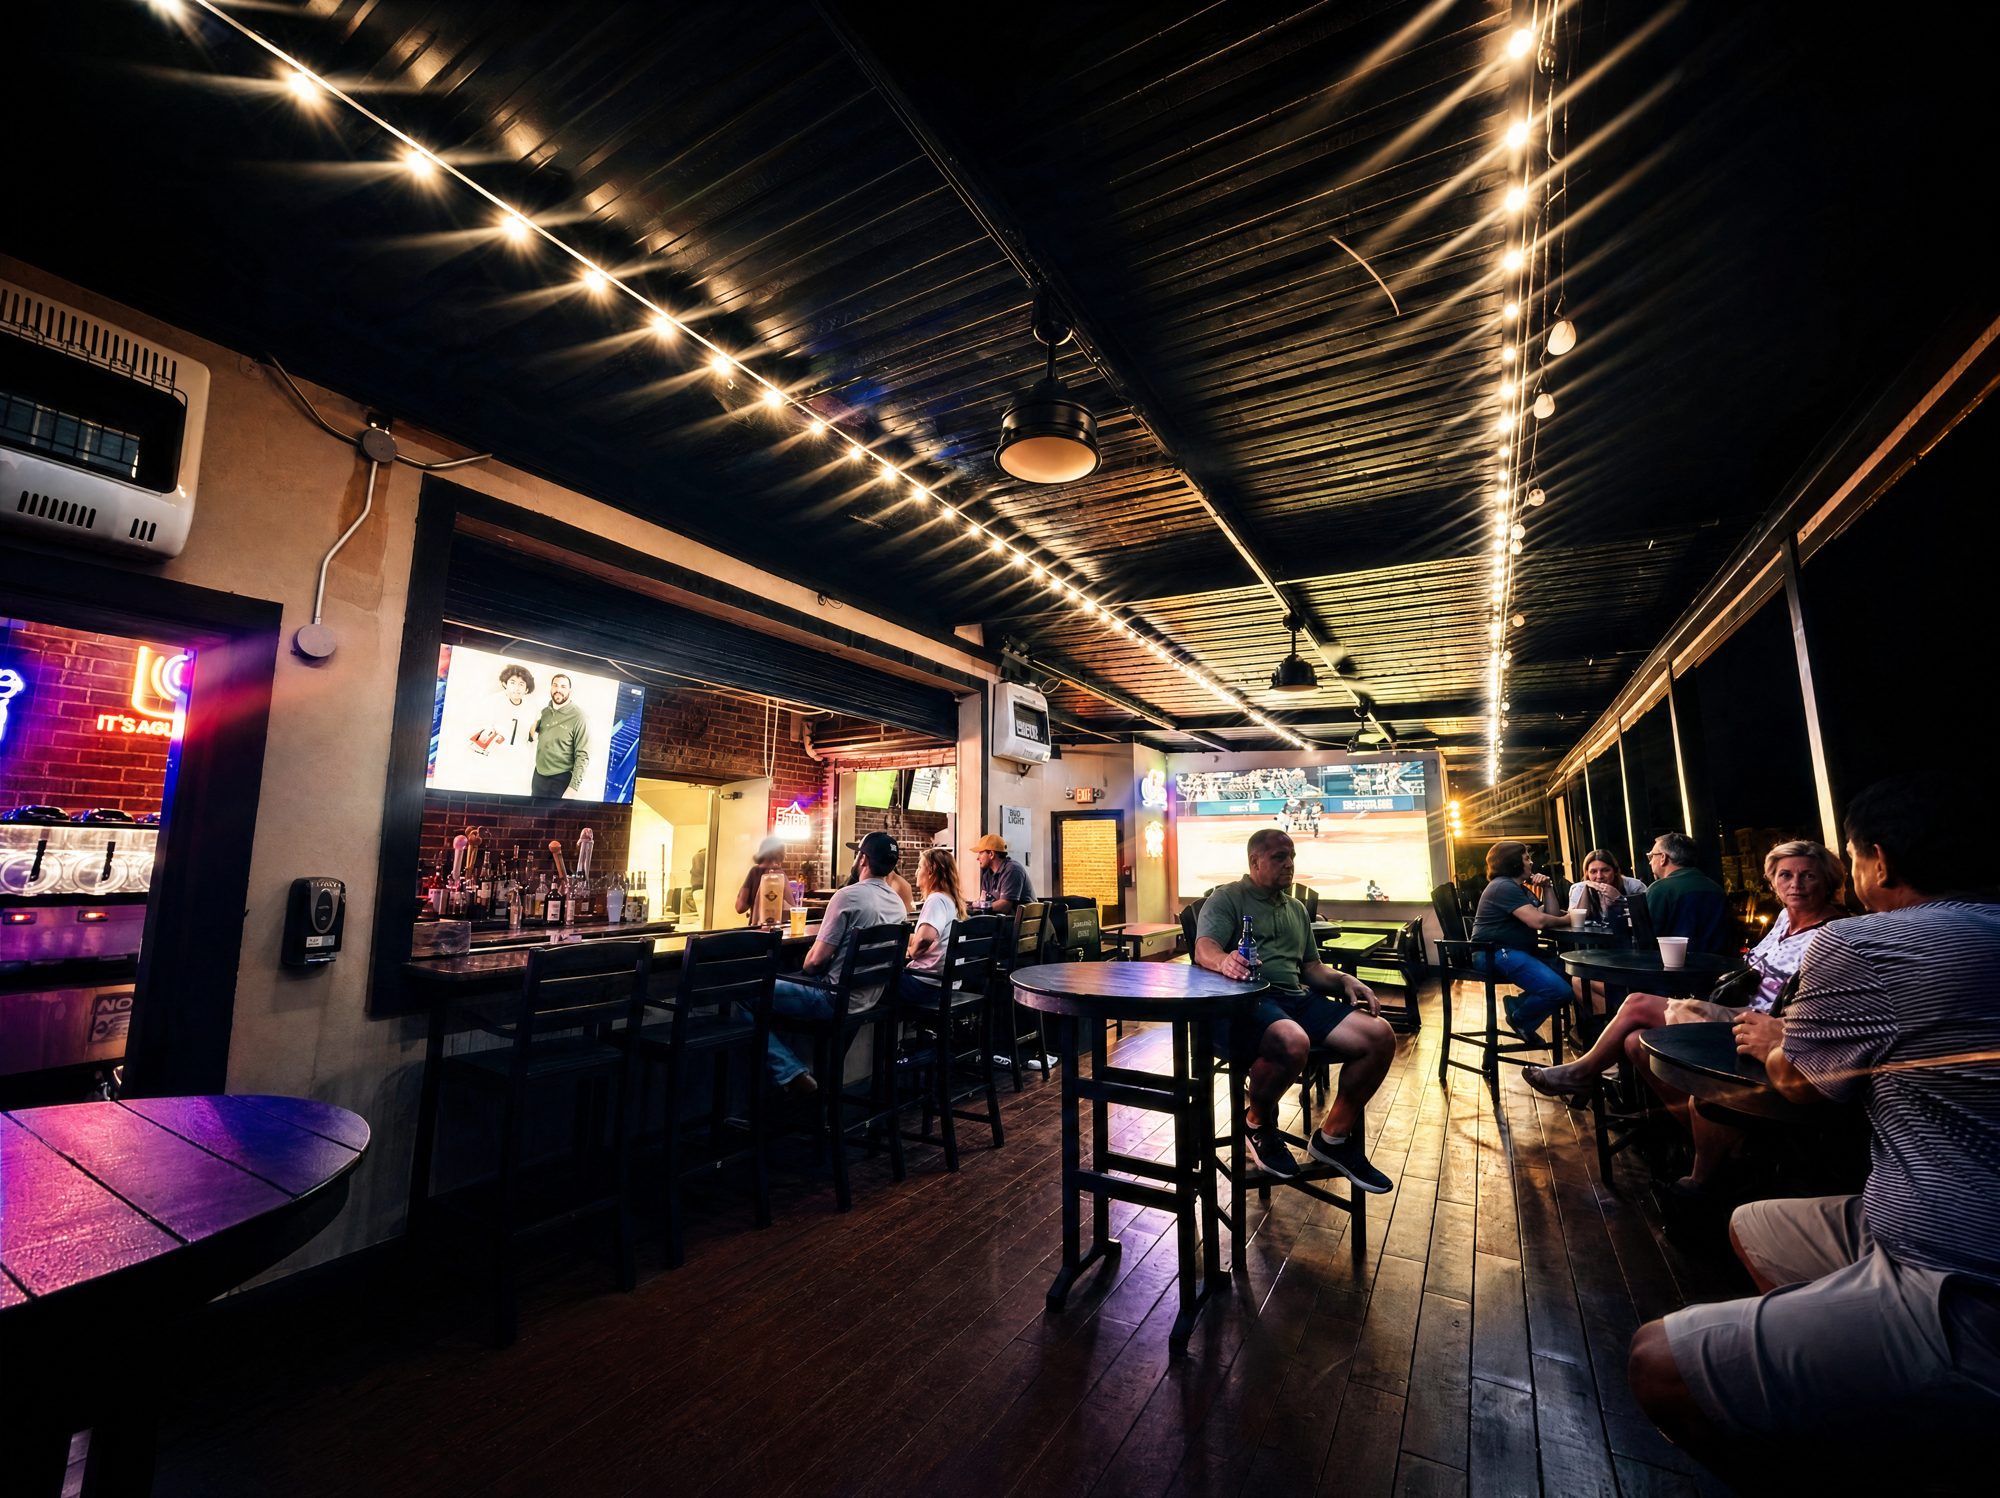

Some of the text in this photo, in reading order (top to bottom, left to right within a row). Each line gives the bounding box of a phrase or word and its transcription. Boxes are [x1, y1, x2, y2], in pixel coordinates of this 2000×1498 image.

[96, 714, 136, 733] IT'S
[1076, 788, 1091, 801] EXIT
[1008, 816, 1024, 825] LIGHT
[98, 997, 133, 1011] NO
